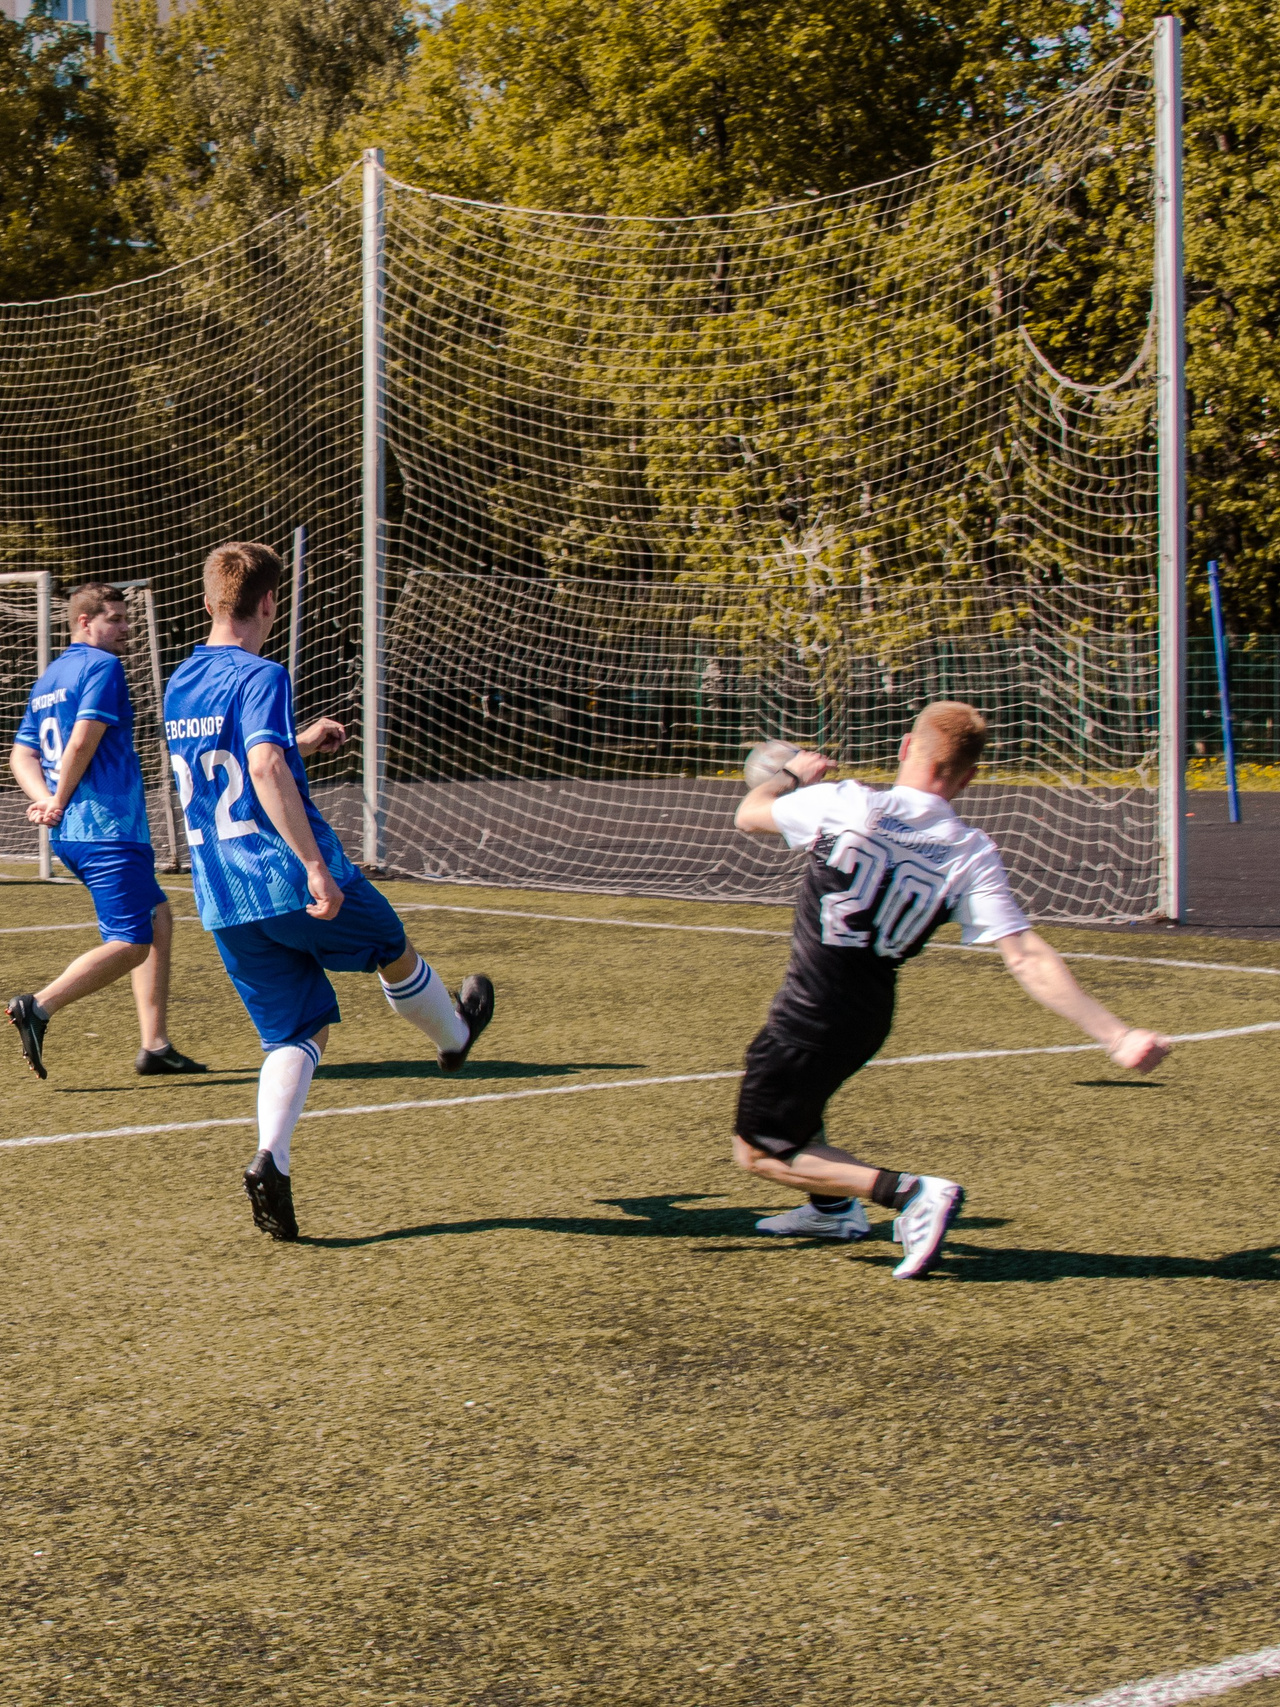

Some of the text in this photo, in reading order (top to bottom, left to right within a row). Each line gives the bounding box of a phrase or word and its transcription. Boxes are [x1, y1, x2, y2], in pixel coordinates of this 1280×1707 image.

[39, 716, 63, 780] 9
[171, 749, 260, 846] 22
[820, 829, 947, 958] 20
